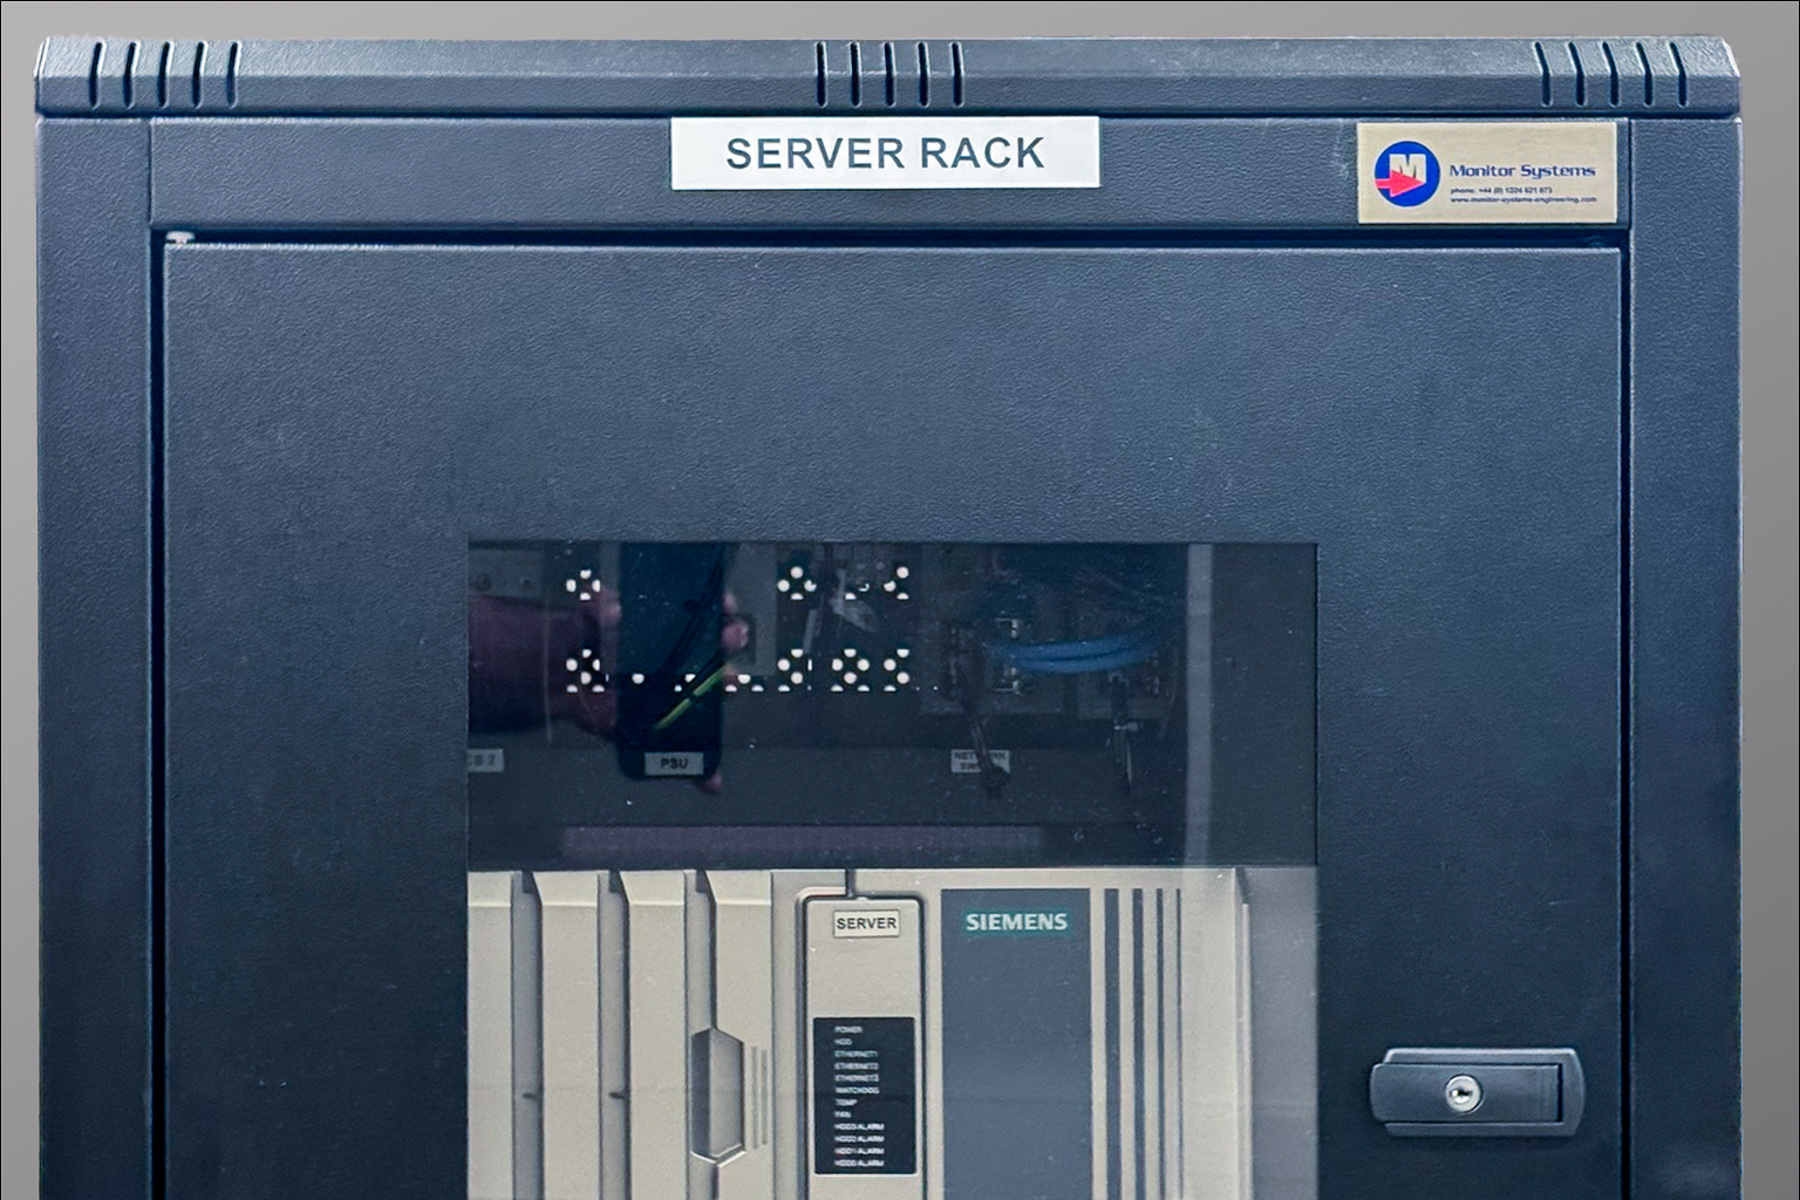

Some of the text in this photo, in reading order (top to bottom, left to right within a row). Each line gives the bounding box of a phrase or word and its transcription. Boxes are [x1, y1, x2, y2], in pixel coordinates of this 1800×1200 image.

[726, 136, 1045, 170] SERVER RACK
[1449, 164, 1596, 180] Monitor Systems
[660, 757, 689, 770] PSU
[836, 917, 898, 930] SERVER
[965, 912, 1068, 932] SIEMENS
[858, 1123, 885, 1131] ALARM
[858, 1135, 885, 1143] ALARM
[858, 1147, 885, 1155] ALARM
[858, 1159, 885, 1167] ALARM
